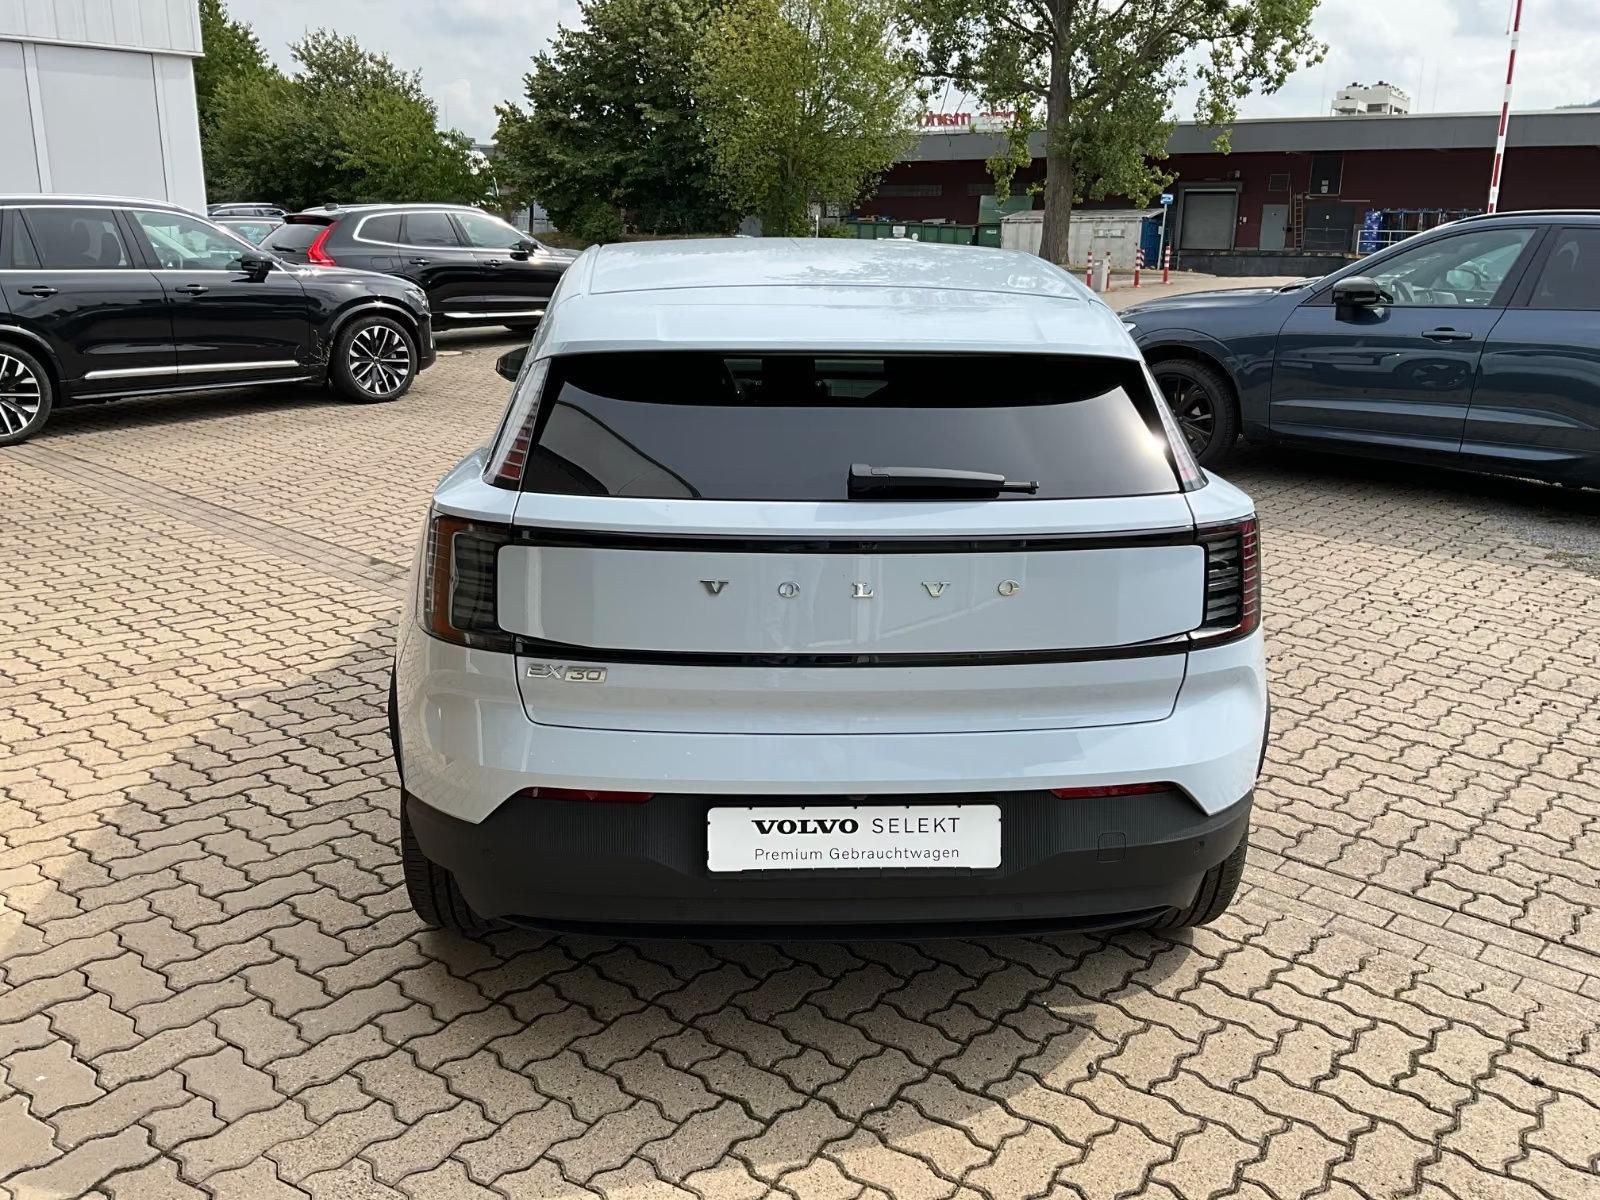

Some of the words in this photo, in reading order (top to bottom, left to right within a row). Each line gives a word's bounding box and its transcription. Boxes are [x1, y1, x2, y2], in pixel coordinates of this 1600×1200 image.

[699, 578, 1021, 599] VOLVO
[751, 818, 859, 835] VOLVO
[871, 817, 961, 834] SELEKT
[754, 848, 823, 861] Premium
[829, 846, 960, 862] Gebrauchtwagen
